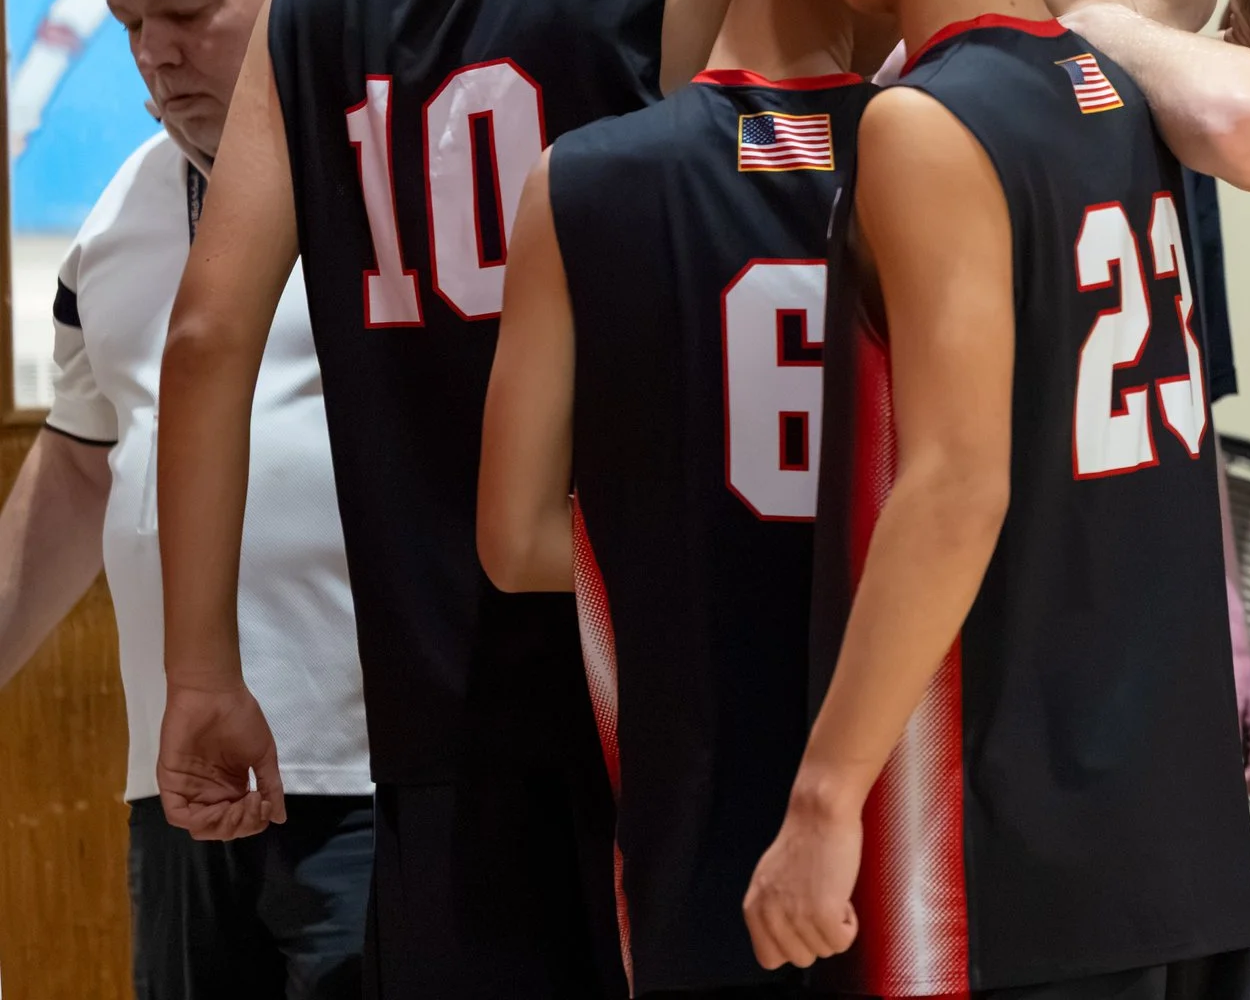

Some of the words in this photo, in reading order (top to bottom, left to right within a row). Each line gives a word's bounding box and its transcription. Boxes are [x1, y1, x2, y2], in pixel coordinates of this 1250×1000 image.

[345, 57, 547, 329] 10
[720, 258, 827, 522] 6
[1073, 190, 1207, 480] 23
